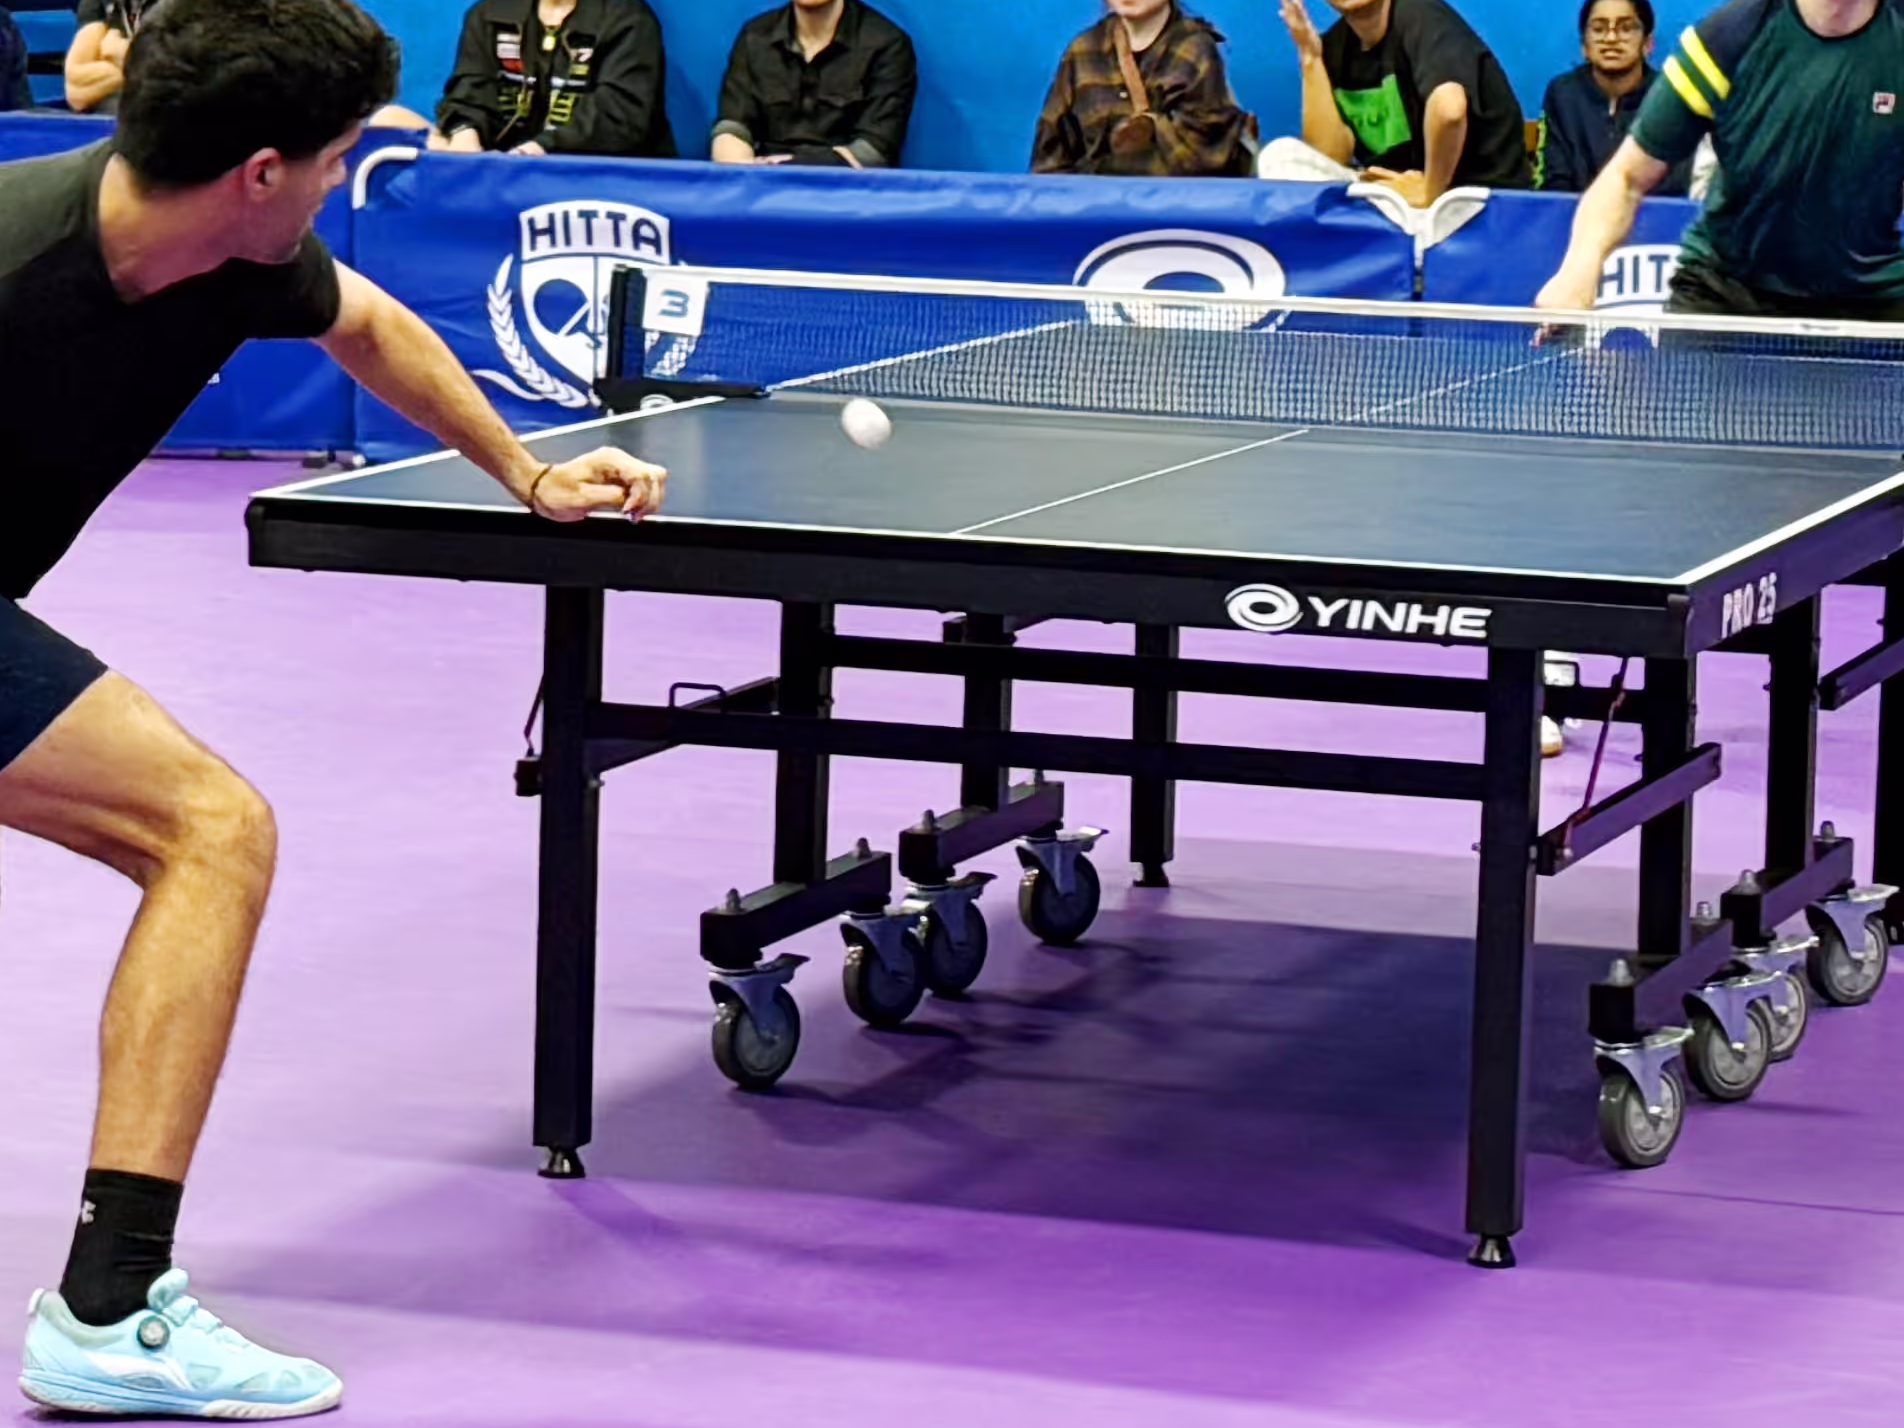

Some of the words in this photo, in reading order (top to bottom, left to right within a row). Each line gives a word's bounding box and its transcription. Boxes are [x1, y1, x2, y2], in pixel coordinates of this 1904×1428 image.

[526, 209, 663, 256] HITTA
[656, 288, 690, 319] 3
[1307, 595, 1493, 640] YINHE
[1721, 582, 1755, 640] PRO
[1756, 571, 1778, 625] 25
